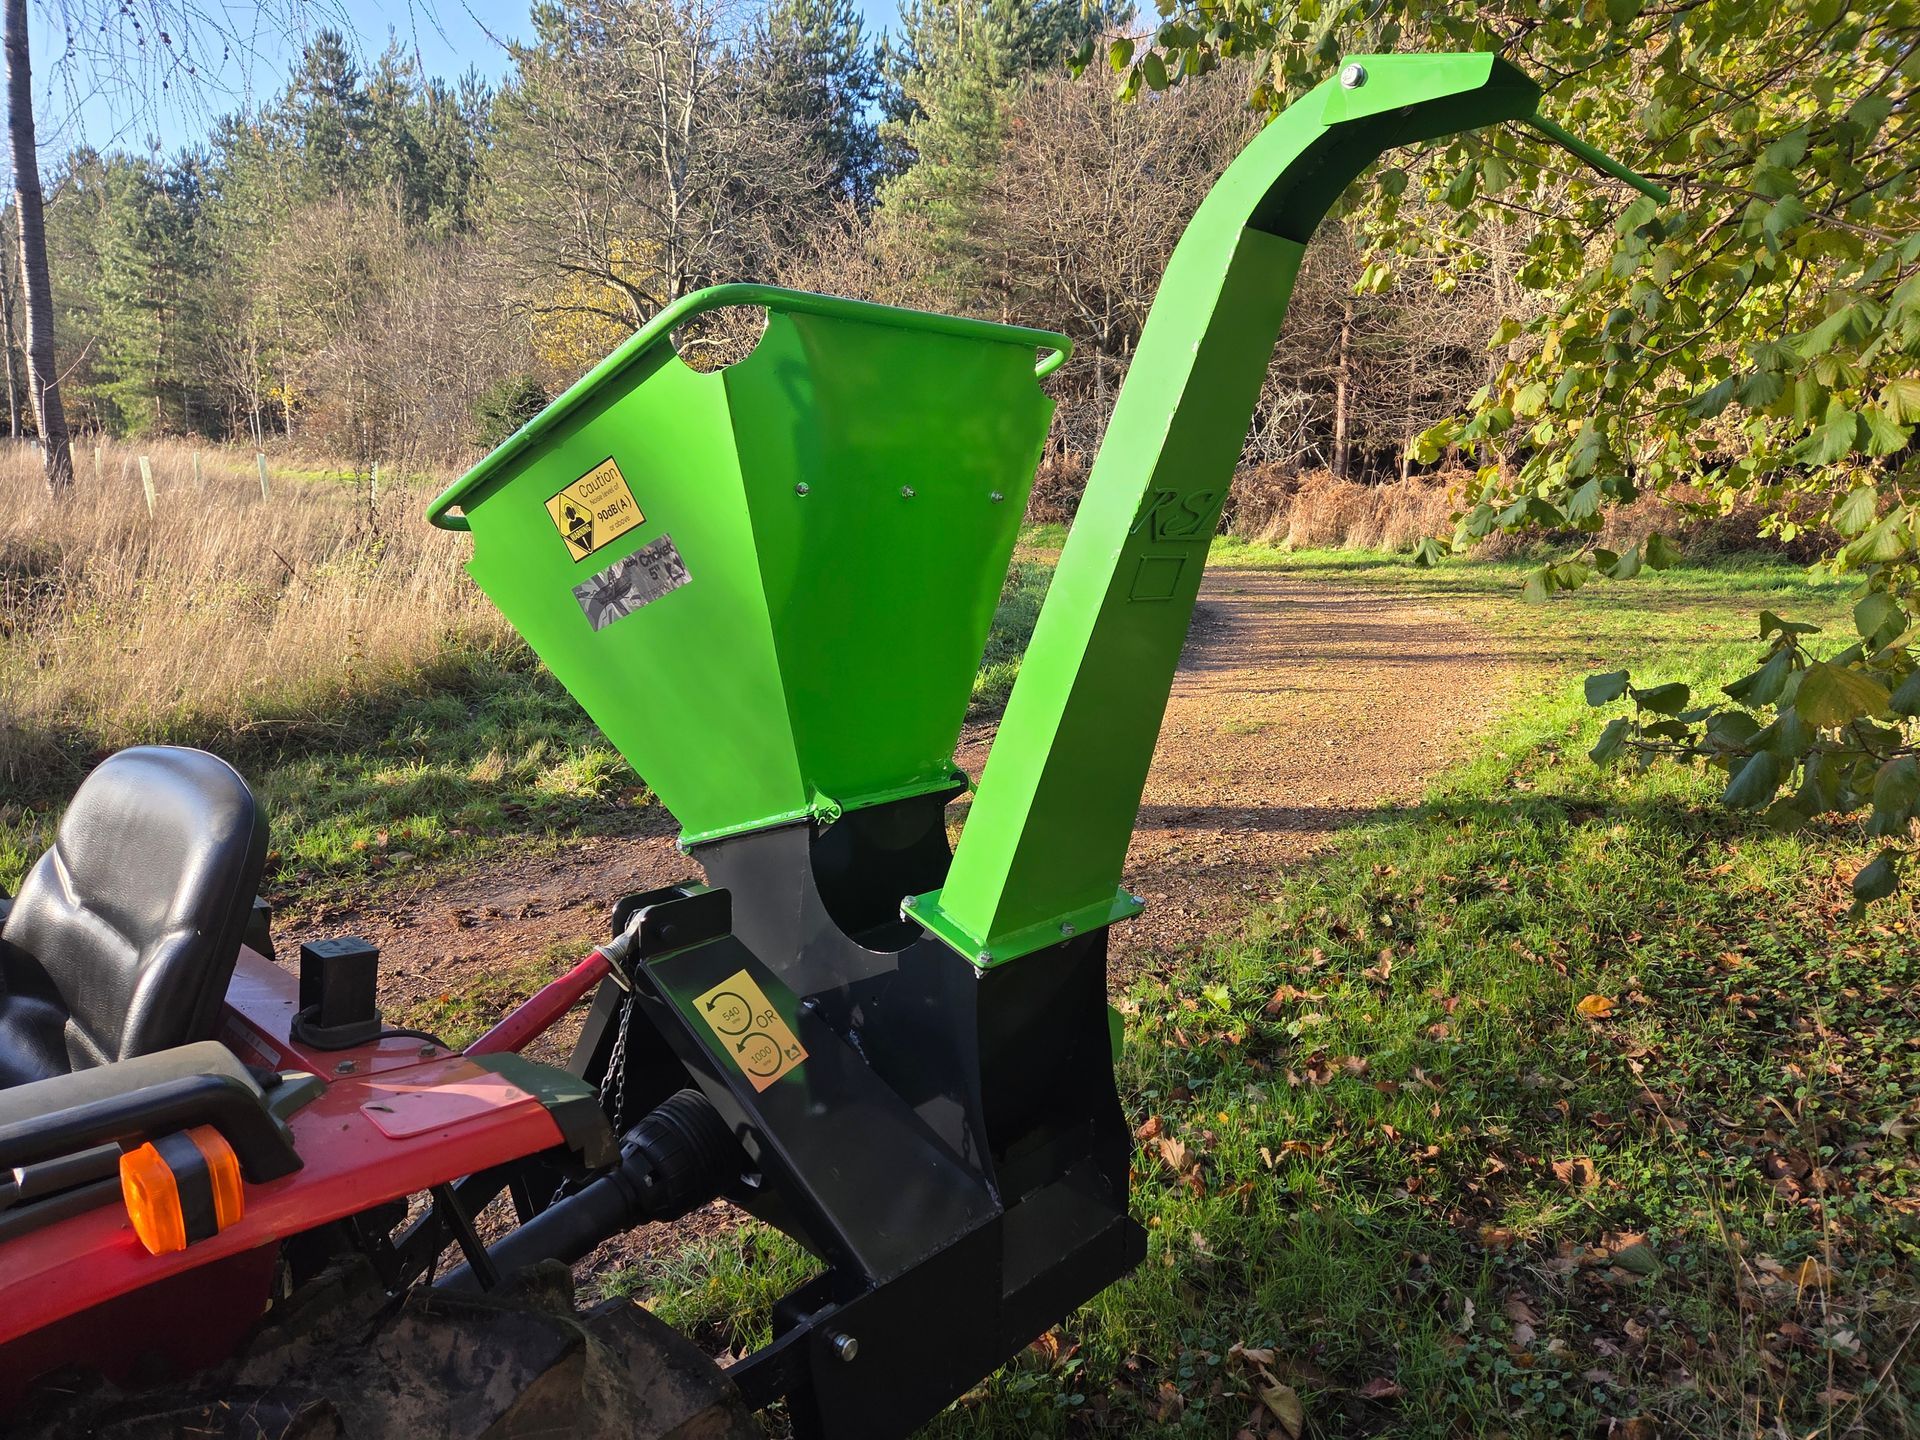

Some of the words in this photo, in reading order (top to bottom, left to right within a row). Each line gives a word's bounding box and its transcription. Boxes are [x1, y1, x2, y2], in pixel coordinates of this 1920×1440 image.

[578, 468, 619, 498] Caution
[589, 494, 602, 505] Noise
[602, 486, 614, 498] level
[597, 495, 632, 522] 90dB(A)
[615, 515, 631, 528] above
[639, 540, 674, 567] Cricket
[722, 1006, 740, 1021] 540
[756, 1010, 778, 1028] OR
[751, 1046, 772, 1064] 1000
